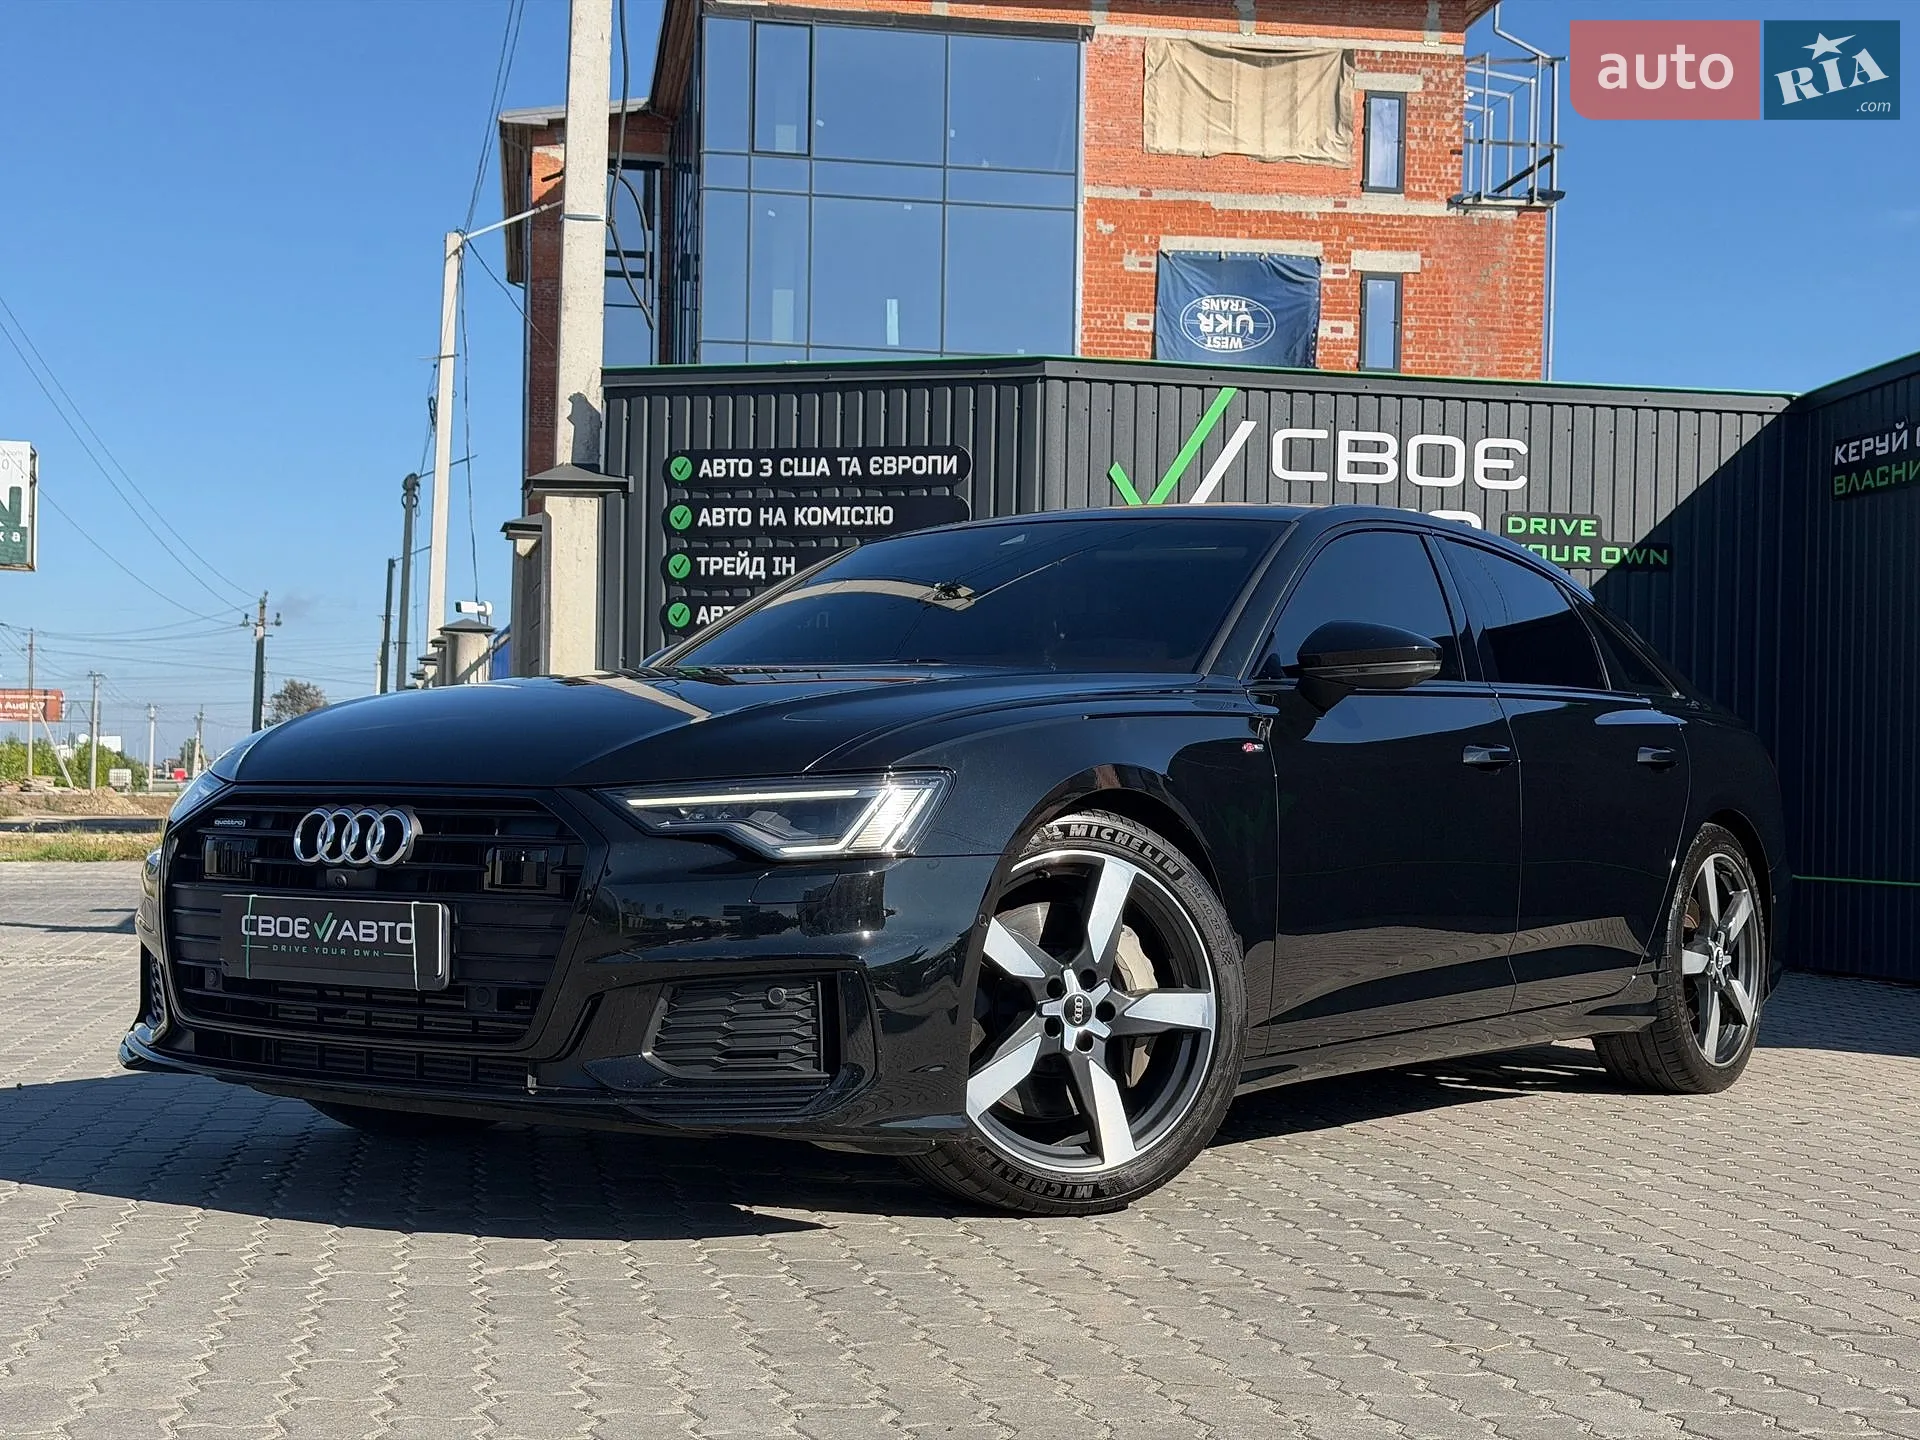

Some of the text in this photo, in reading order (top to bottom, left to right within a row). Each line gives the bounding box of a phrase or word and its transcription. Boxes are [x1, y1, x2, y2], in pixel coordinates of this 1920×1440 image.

[1201, 298, 1249, 312] TRANS
[1196, 312, 1254, 334] UKR
[1206, 336, 1244, 350] WEST
[1834, 421, 1908, 465] КЕРУЙ
[698, 455, 958, 478] АВТО З США ТА ЄВРОПИ
[1271, 428, 1529, 490] СВОЄ
[697, 506, 894, 527] АВТО НА КОМІСІЮ
[1507, 516, 1597, 537] DRIVE
[696, 550, 796, 580] ТРЕЙД ІН
[1521, 544, 1668, 565] OUR OWN
[1069, 824, 1181, 877] MICHELIN
[241, 915, 414, 944] СВОЄ АВТО
[272, 945, 380, 957] DRIVE YOUR OWN
